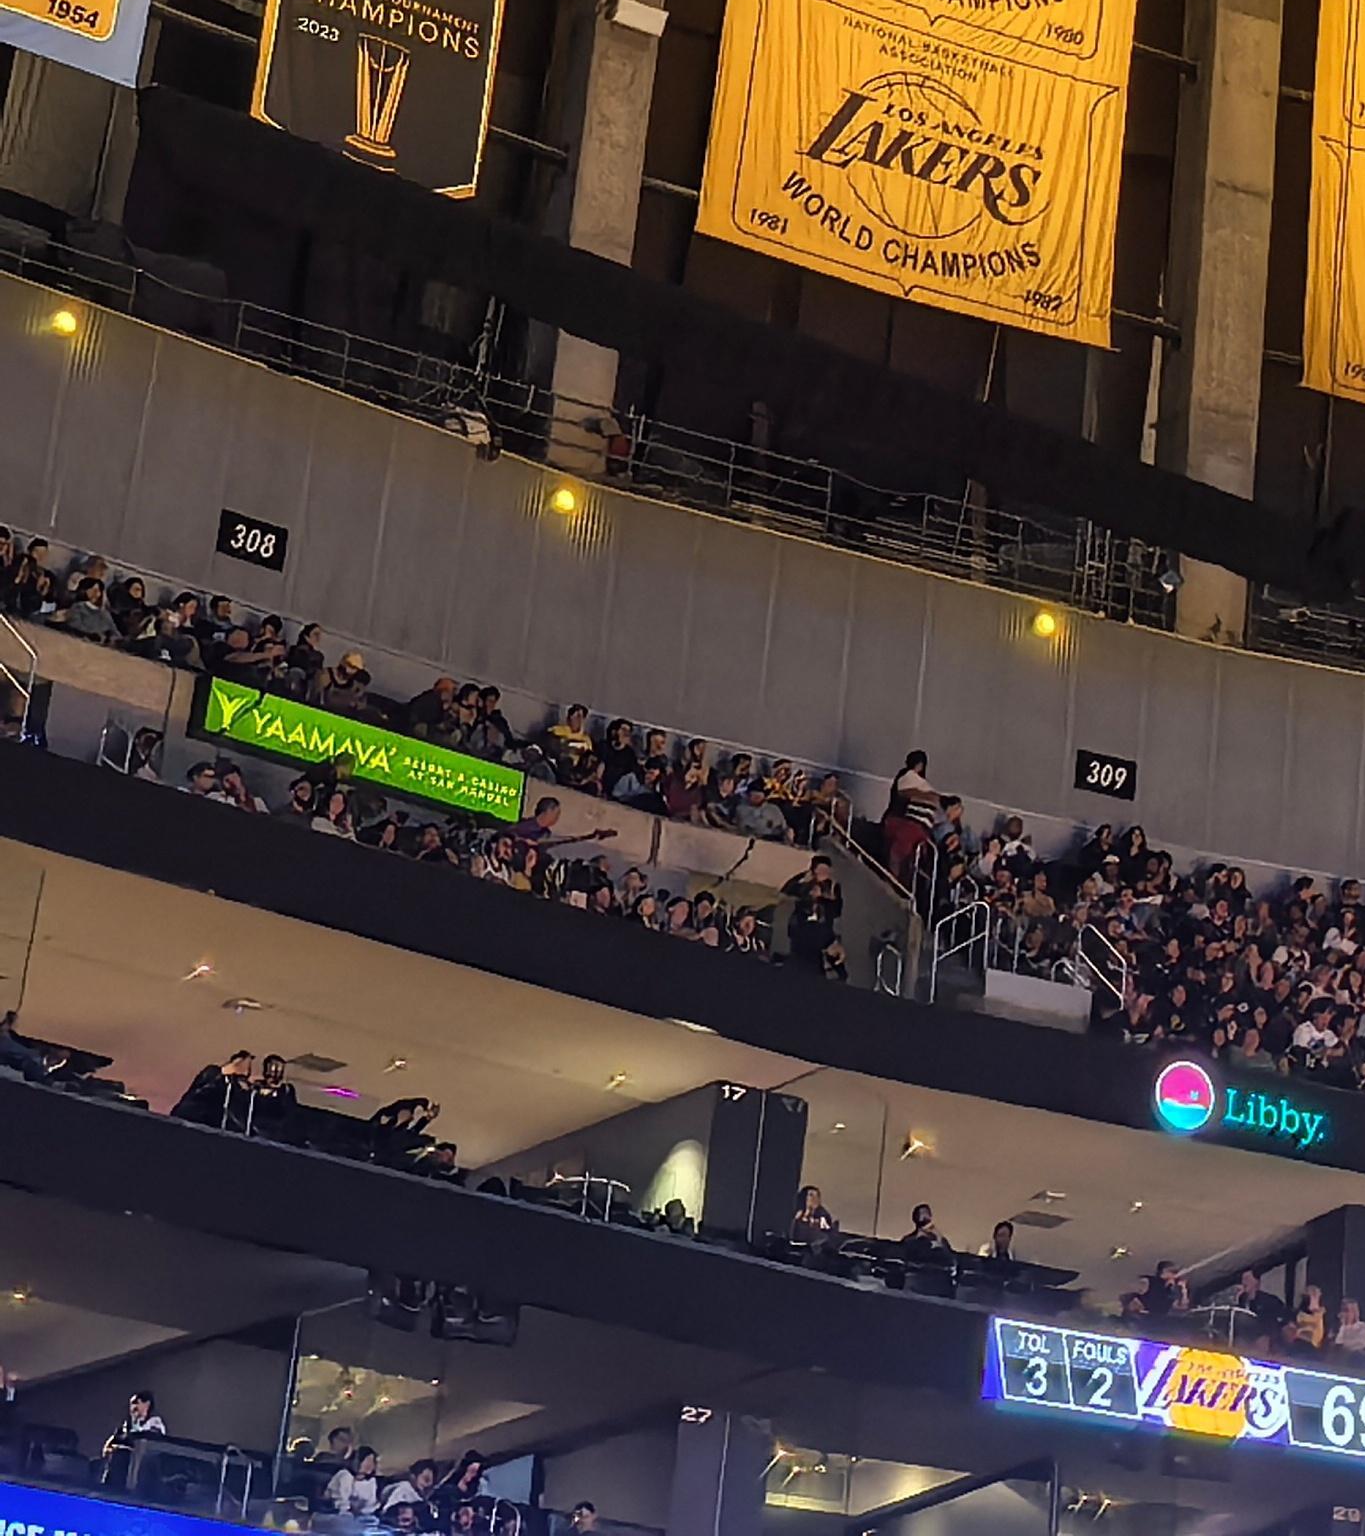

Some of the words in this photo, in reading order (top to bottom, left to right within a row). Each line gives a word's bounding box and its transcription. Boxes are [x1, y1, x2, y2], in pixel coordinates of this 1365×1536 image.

[297, 18, 339, 42] 2023
[794, 88, 1050, 225] LAKERS
[749, 207, 789, 235] 1981
[782, 170, 873, 252] WORLD
[882, 240, 1041, 278] CHAMPIONS
[230, 523, 276, 558] 308
[1086, 760, 1127, 790] 309
[722, 1085, 746, 1100] 17
[1017, 1330, 1052, 1355] TOL
[1073, 1340, 1128, 1366] FOULS
[1026, 1354, 1047, 1397] 3
[1089, 1366, 1112, 1406] 2
[681, 1406, 712, 1423] 27
[1141, 1360, 1287, 1437] LAKERS
